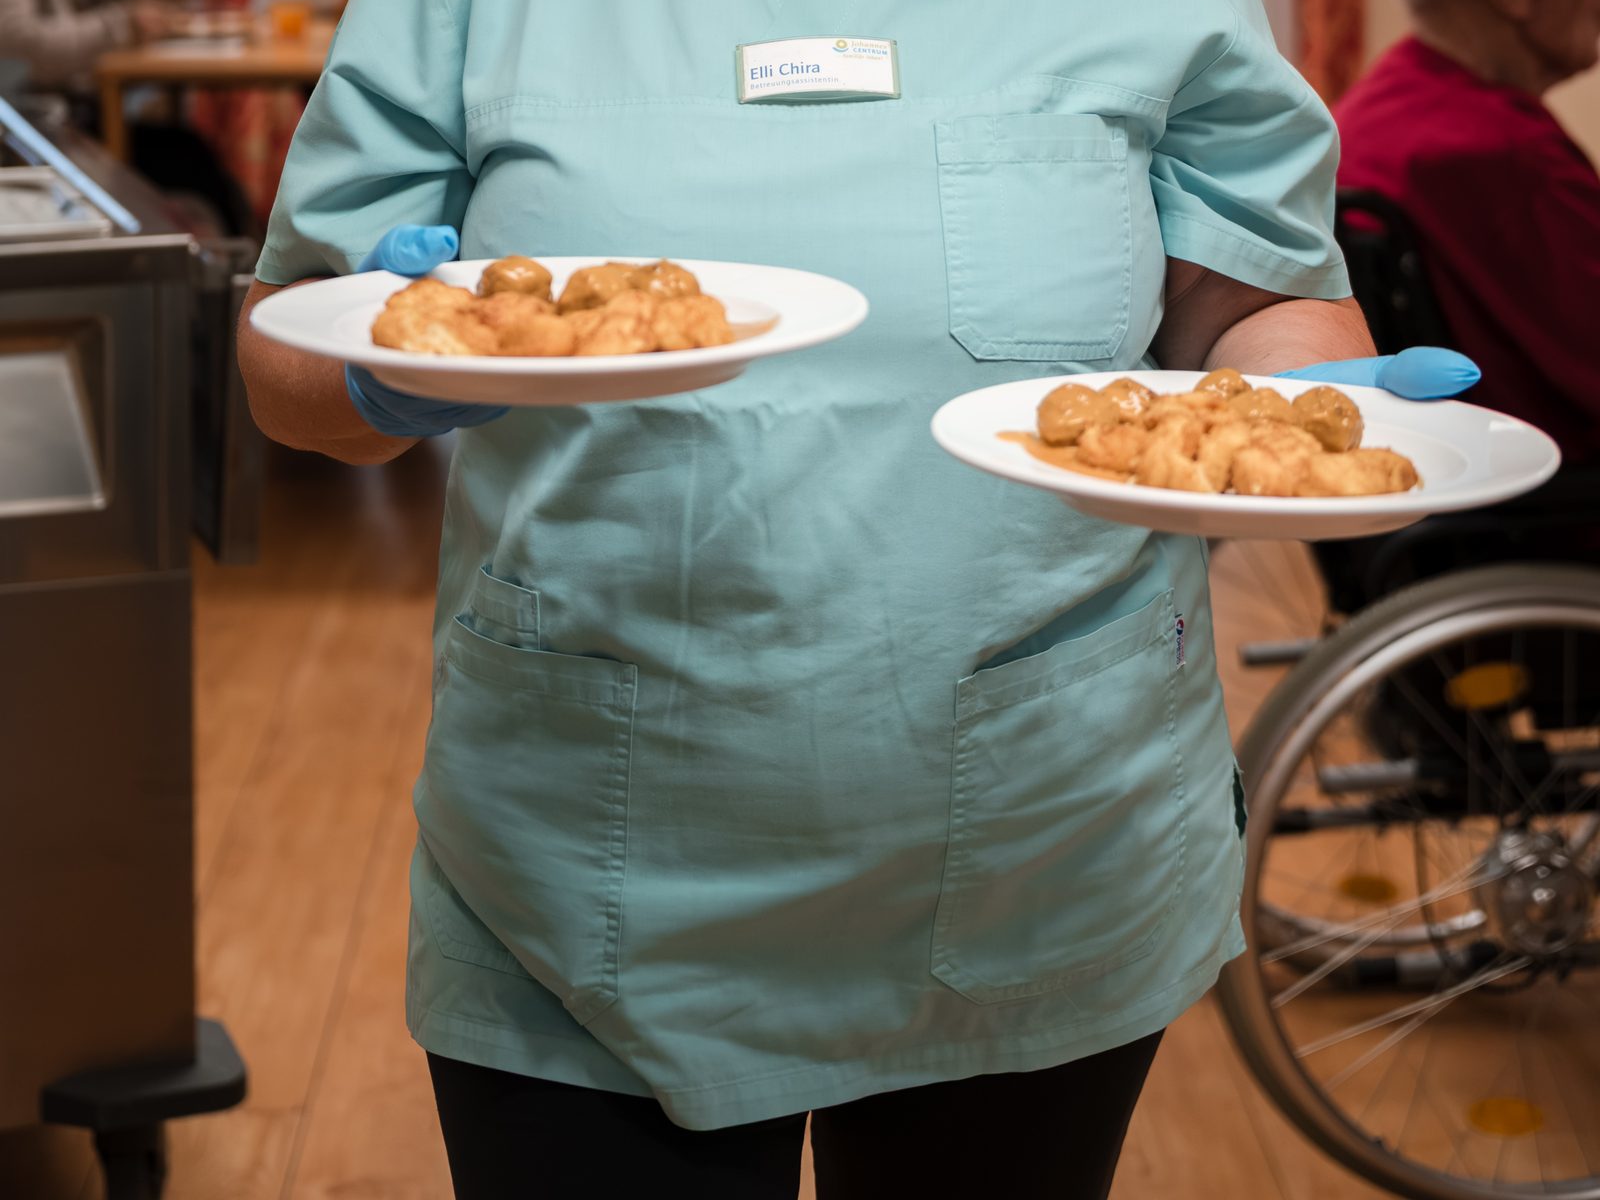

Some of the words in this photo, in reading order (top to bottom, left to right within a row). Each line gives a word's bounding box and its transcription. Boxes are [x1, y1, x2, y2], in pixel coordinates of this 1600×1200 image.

[853, 47, 889, 56] CENTRUM
[750, 64, 773, 80] Elli
[779, 61, 820, 76] Chira
[750, 77, 839, 90] Betreuungsassistentin
